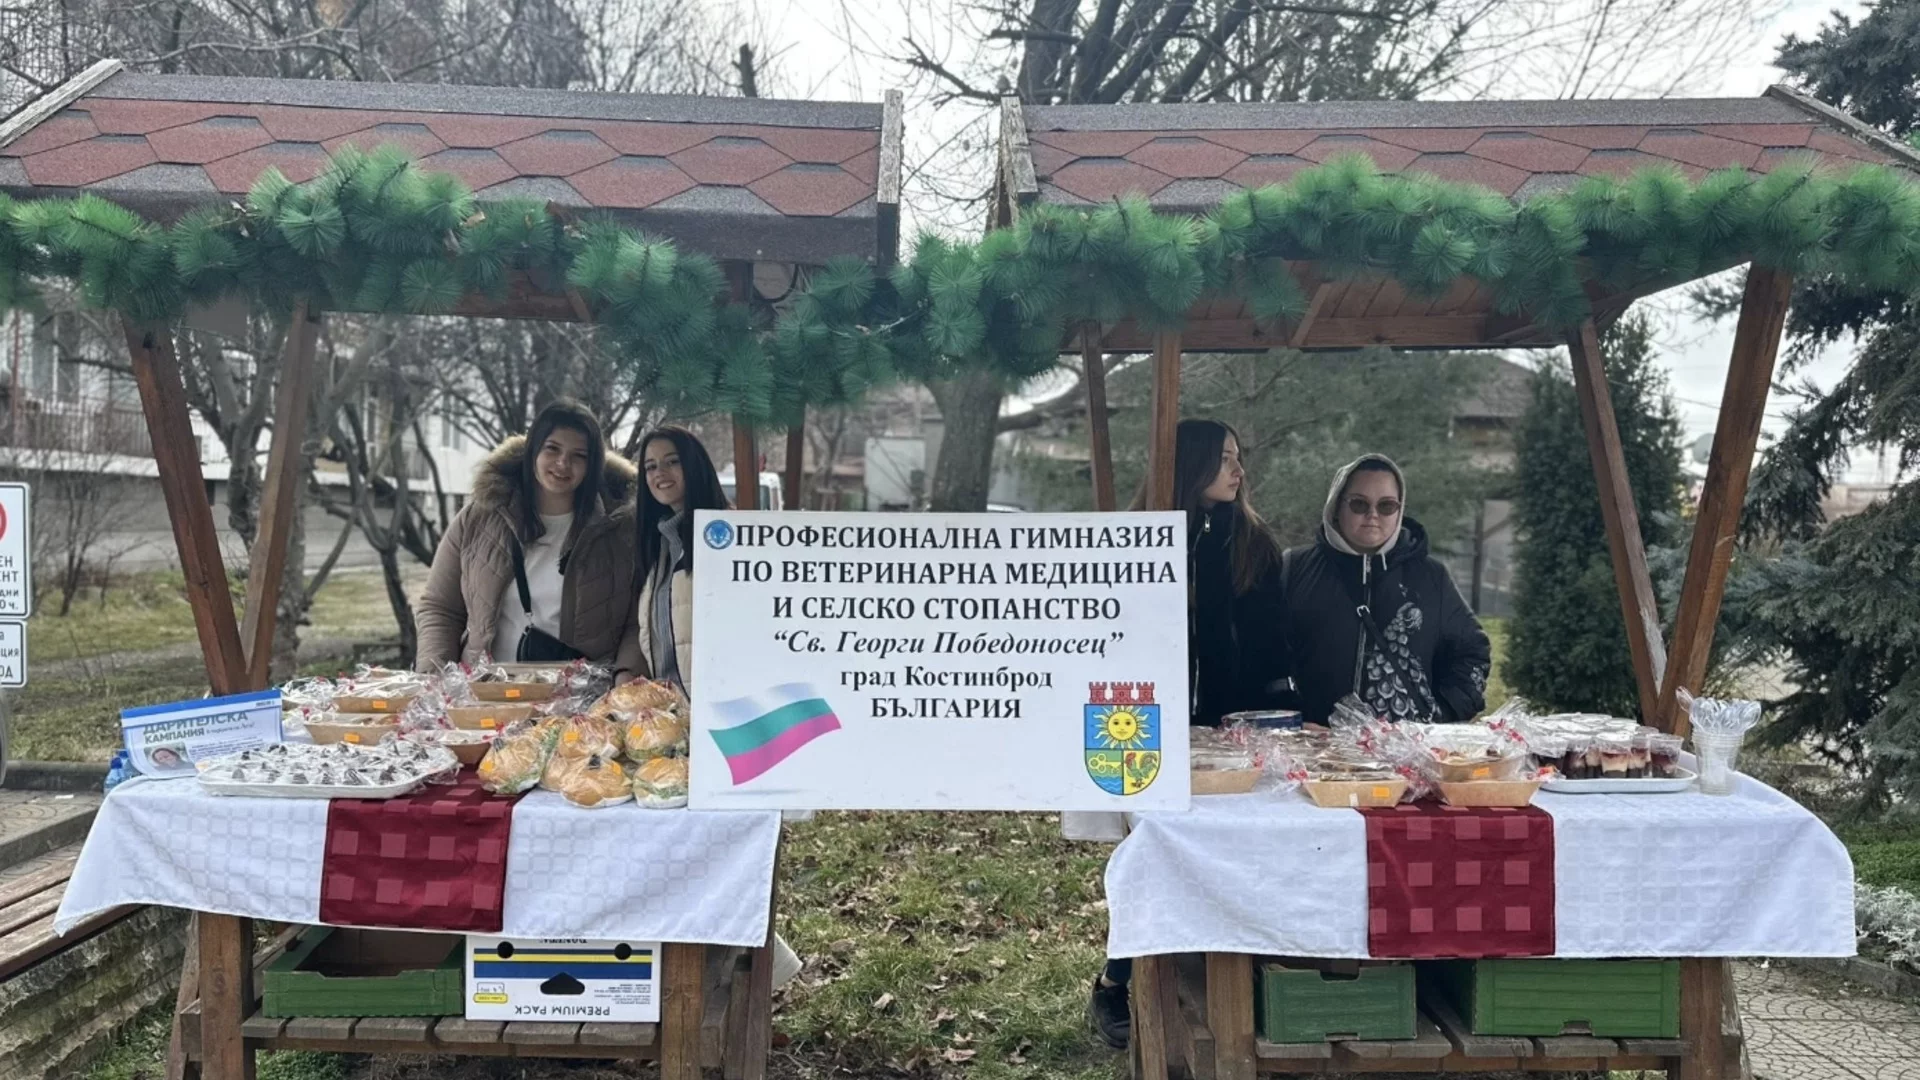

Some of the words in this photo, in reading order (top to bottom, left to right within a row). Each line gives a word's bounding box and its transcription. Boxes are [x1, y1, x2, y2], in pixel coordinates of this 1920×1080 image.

[735, 524, 1001, 549] ПРОФЕСИОНАЛНА
[1010, 525, 1174, 549] ГИМНАЗИЯ
[732, 560, 773, 582] ПО
[781, 560, 997, 584] ВЕТЕРИНАРНА
[1005, 561, 1178, 589] МЕДИЦИНА
[772, 596, 793, 618] И
[801, 596, 915, 619] СЕЛСКО
[924, 598, 1121, 620] СТОПАНСТВО
[835, 630, 925, 660] Георги
[932, 630, 1125, 659] Победоносец”
[840, 669, 896, 691] град
[905, 665, 1053, 692] Костинброд
[870, 697, 1022, 718] БЪЛГАРИЯ
[143, 710, 249, 735] ДАРИТЕЛСКА
[144, 727, 205, 744] КАМПАНИЯ
[515, 1005, 547, 1015] PACK
[551, 1006, 610, 1016] PREMIUM
